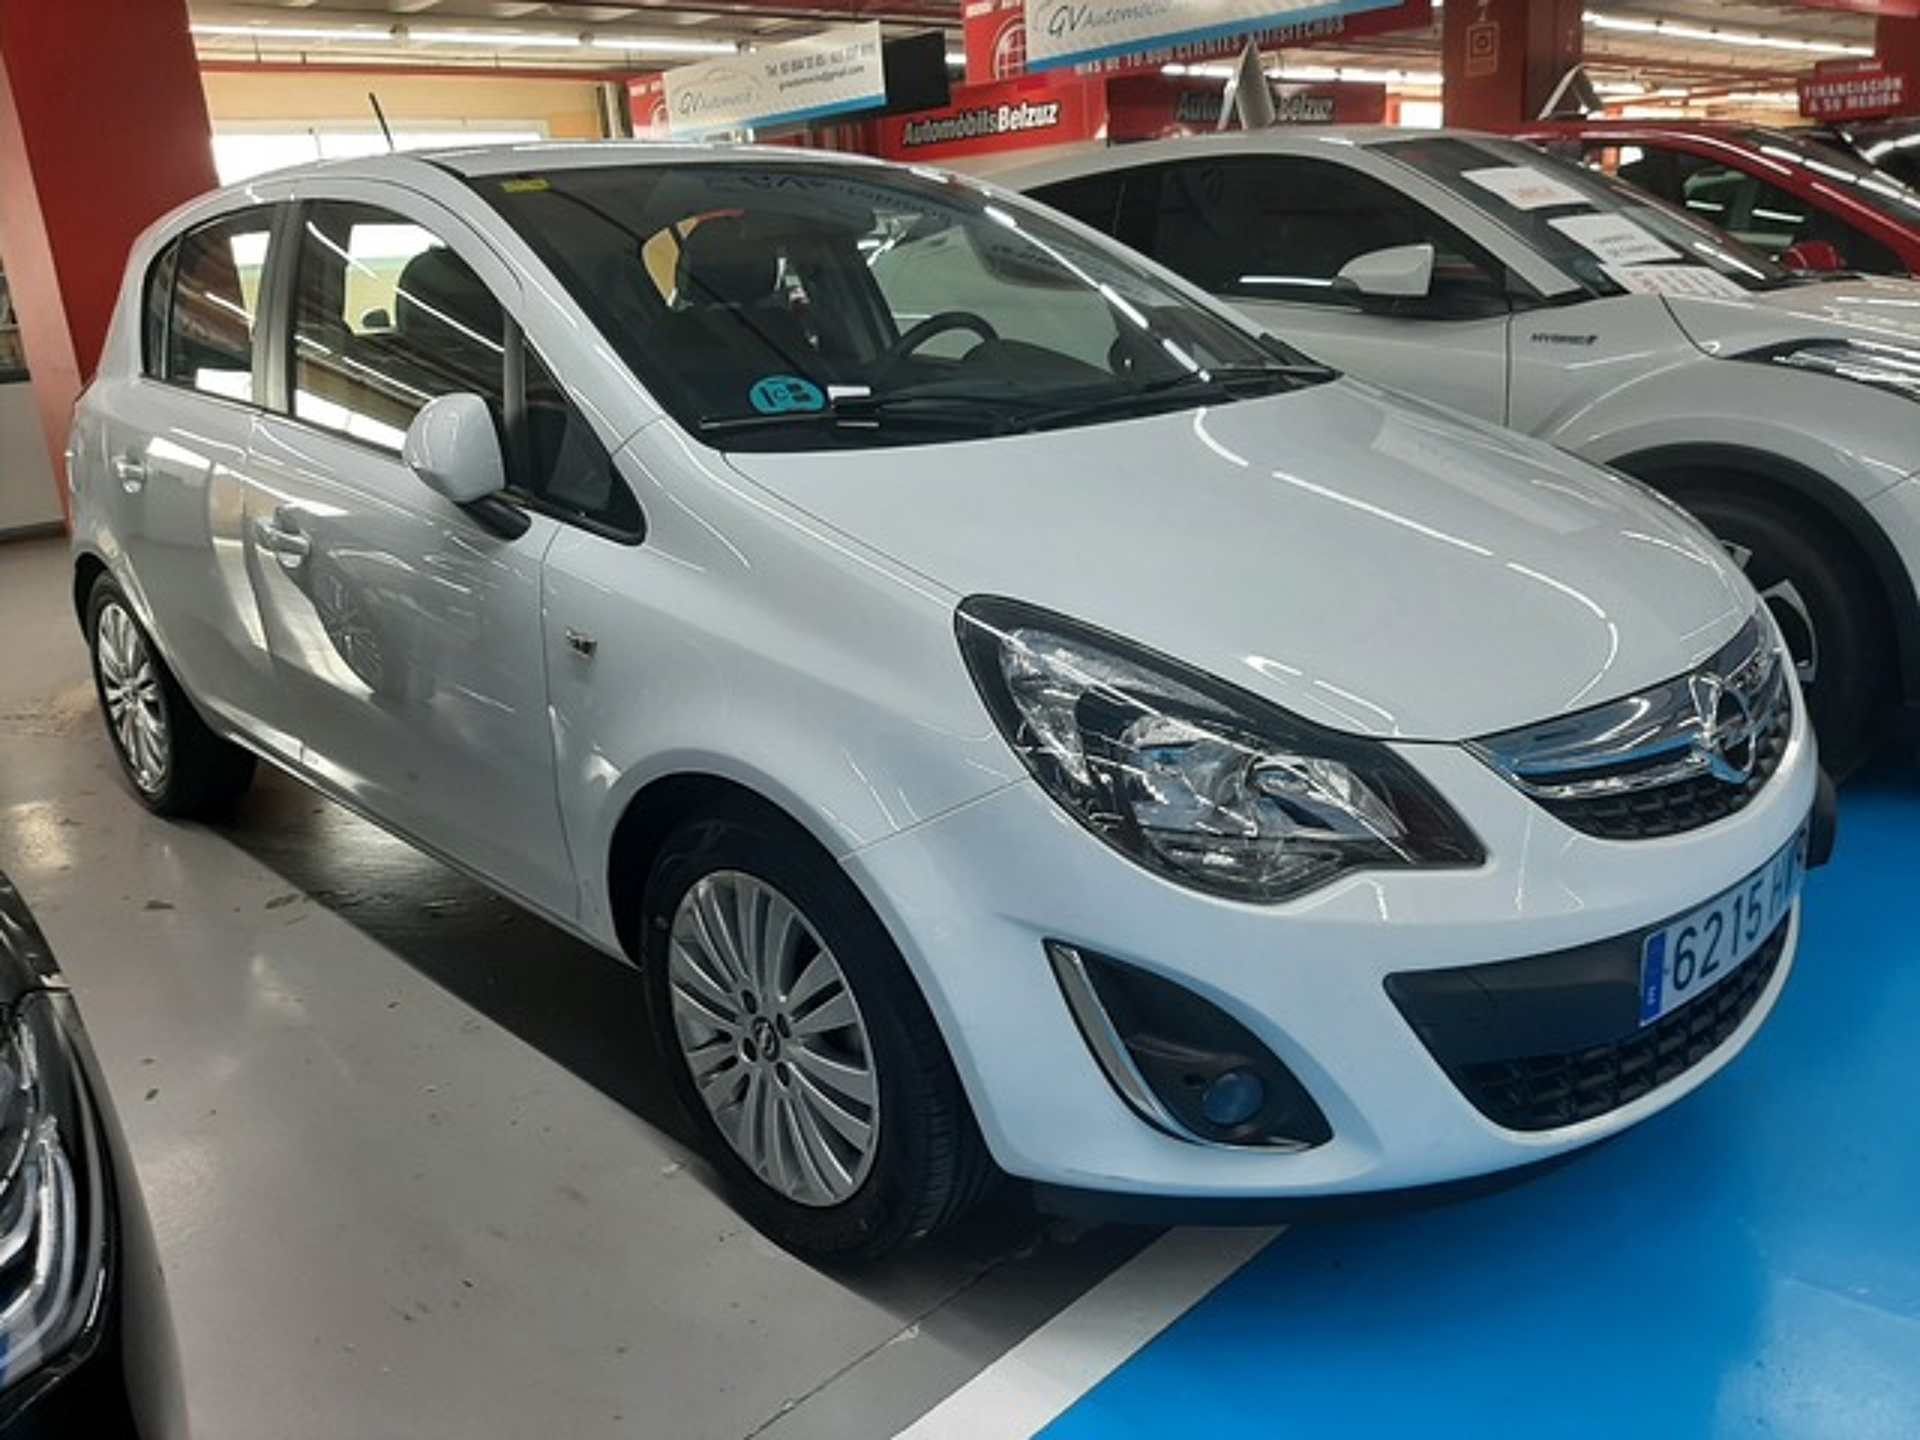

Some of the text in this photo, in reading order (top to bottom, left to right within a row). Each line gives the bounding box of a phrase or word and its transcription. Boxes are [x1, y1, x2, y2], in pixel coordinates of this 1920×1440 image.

[1174, 32, 1240, 62] CLIENTES
[1246, 13, 1346, 46] SATISFECHOS
[1672, 878, 1764, 992] 6215
